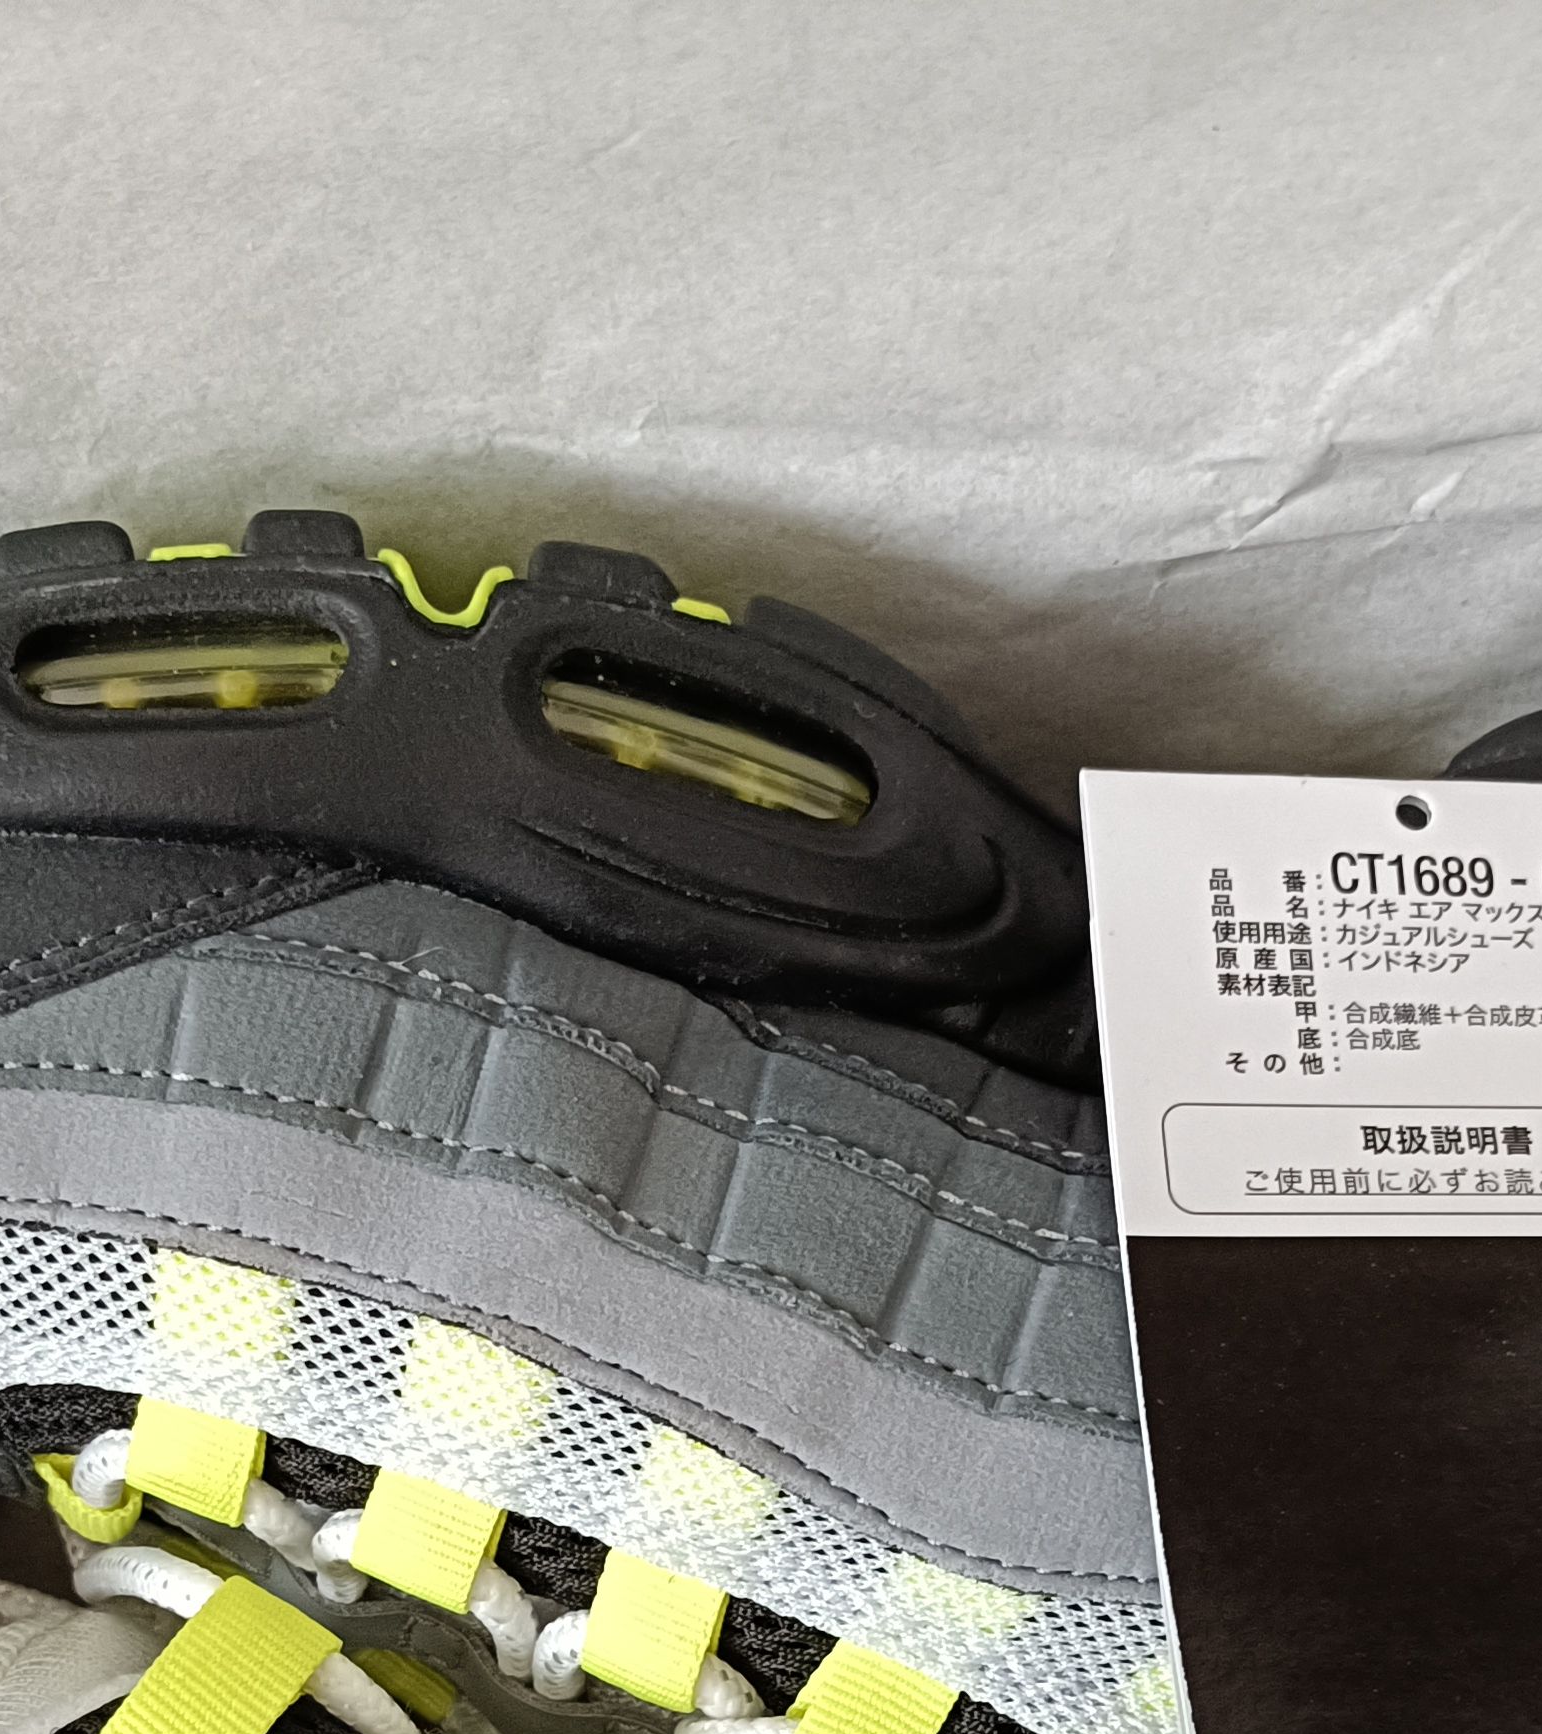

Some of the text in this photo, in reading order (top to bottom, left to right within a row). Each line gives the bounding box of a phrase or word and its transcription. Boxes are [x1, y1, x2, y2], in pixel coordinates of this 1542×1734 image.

[1330, 851, 1495, 898] CT1689
[1332, 898, 1400, 921] ナイキ
[1408, 901, 1453, 922] エア
[1335, 922, 1535, 950] カジュアルシューズ
[1338, 950, 1471, 974] インドネシア
[1217, 972, 1317, 998] 素材表記
[1345, 1027, 1422, 1051] 合成底
[1360, 1125, 1534, 1155] 取扱説明書
